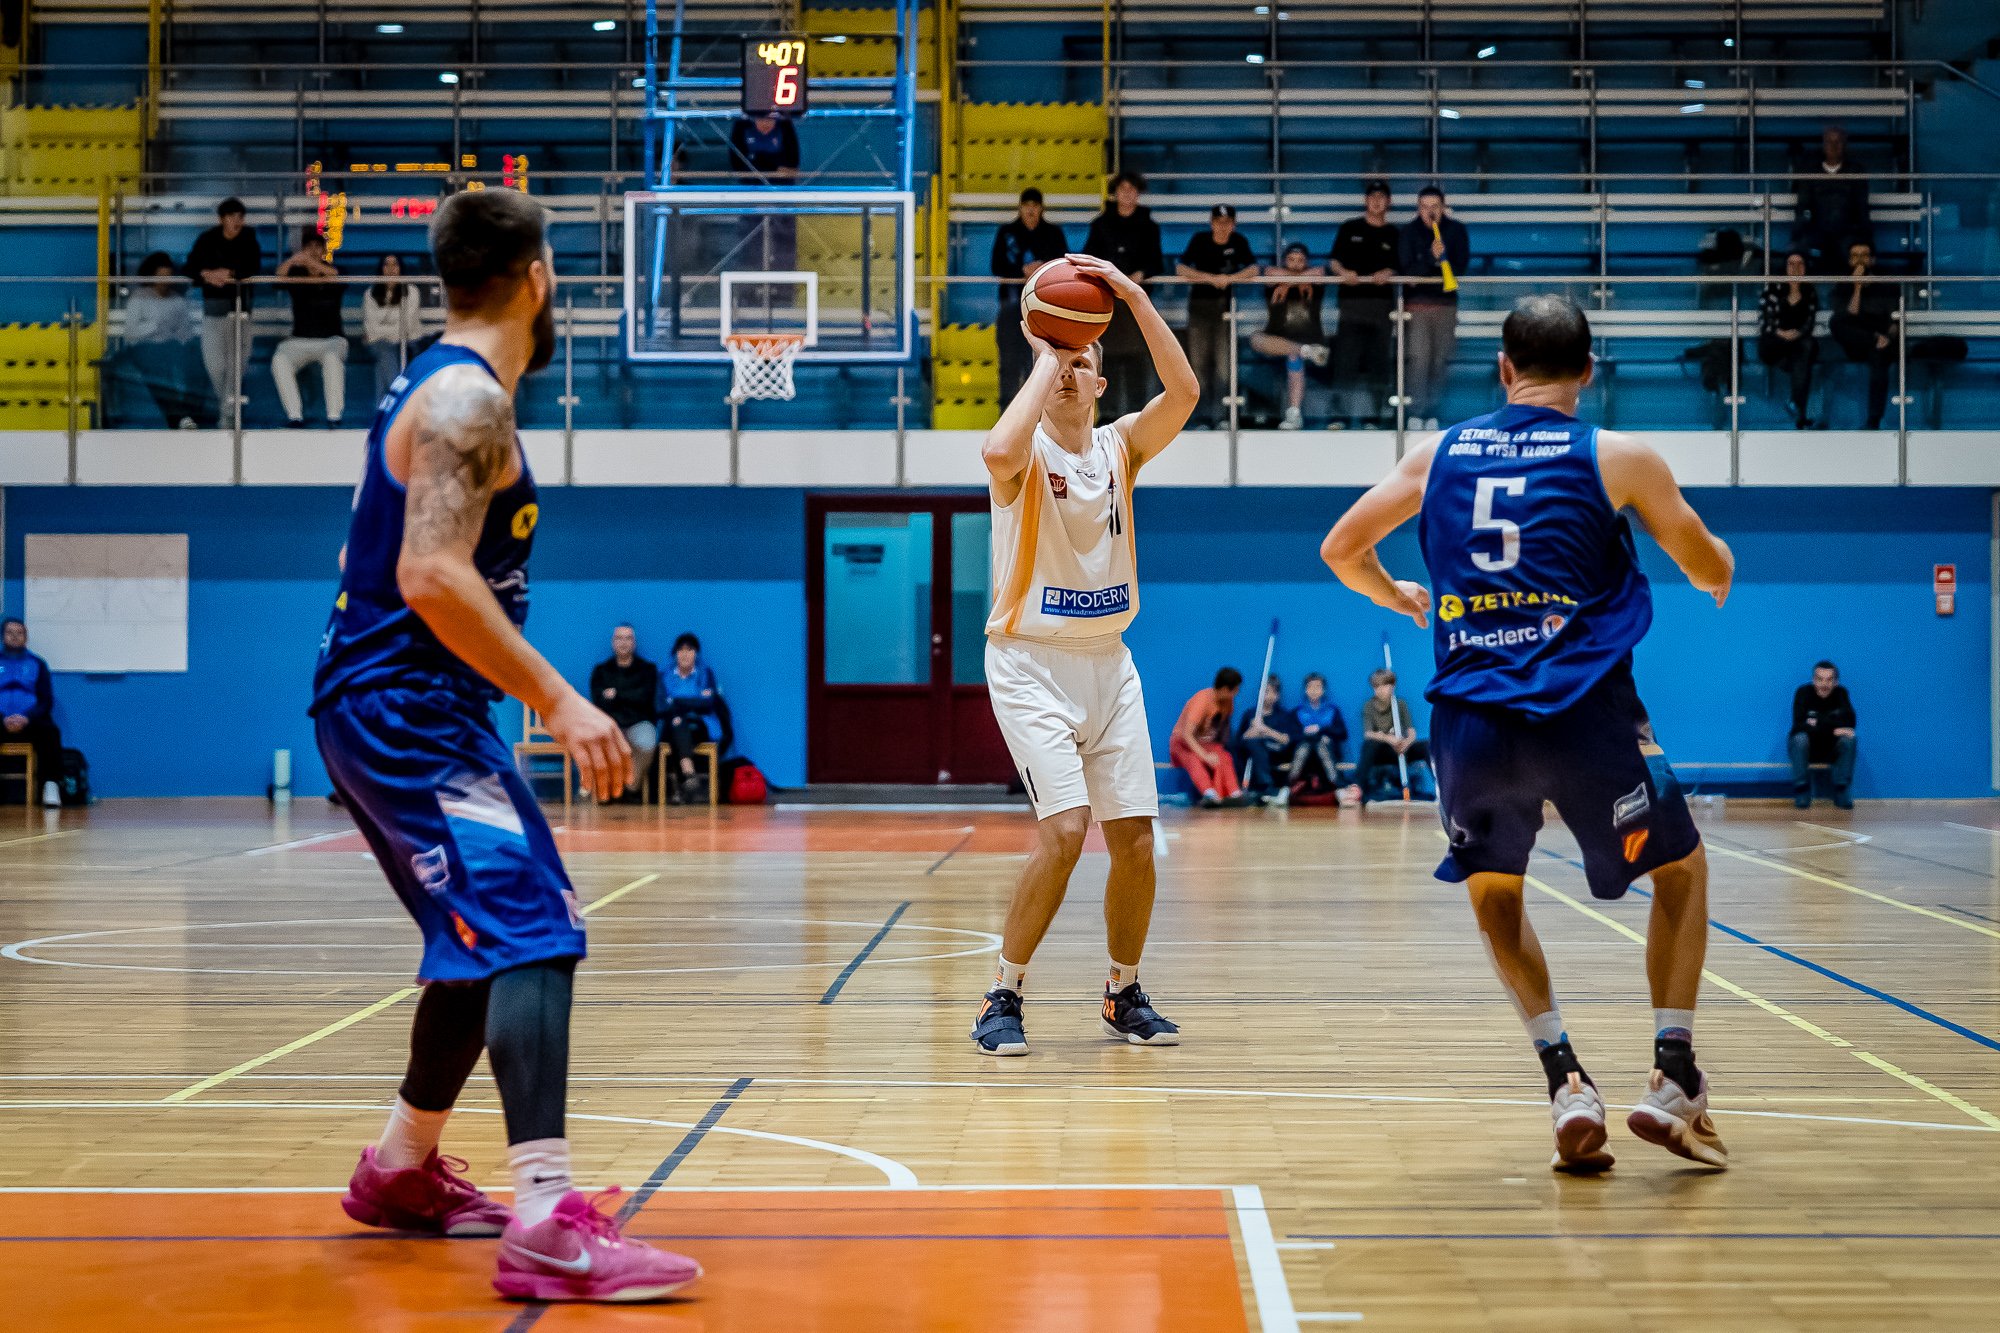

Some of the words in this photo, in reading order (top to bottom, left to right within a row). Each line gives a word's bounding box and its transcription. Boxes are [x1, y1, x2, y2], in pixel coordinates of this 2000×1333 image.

[774, 65, 799, 106] 6
[1470, 476, 1526, 572] 5
[1062, 585, 1128, 607] MODERN
